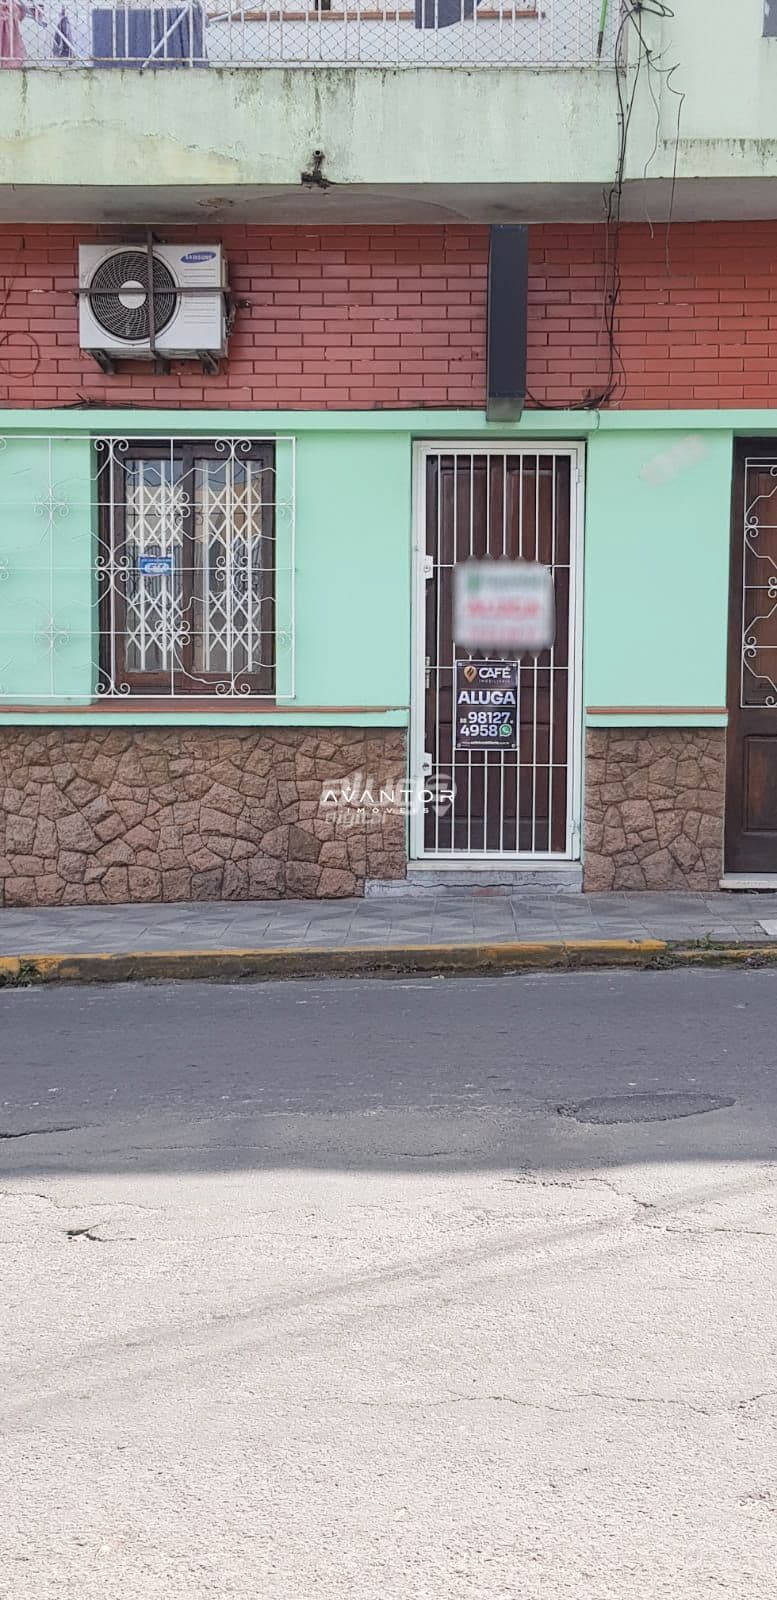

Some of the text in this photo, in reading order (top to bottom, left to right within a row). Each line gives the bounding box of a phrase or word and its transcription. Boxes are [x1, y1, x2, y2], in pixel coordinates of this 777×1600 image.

[478, 667, 511, 678] CAFÉ
[457, 691, 516, 705] ALUGA
[460, 724, 498, 737] 4958
